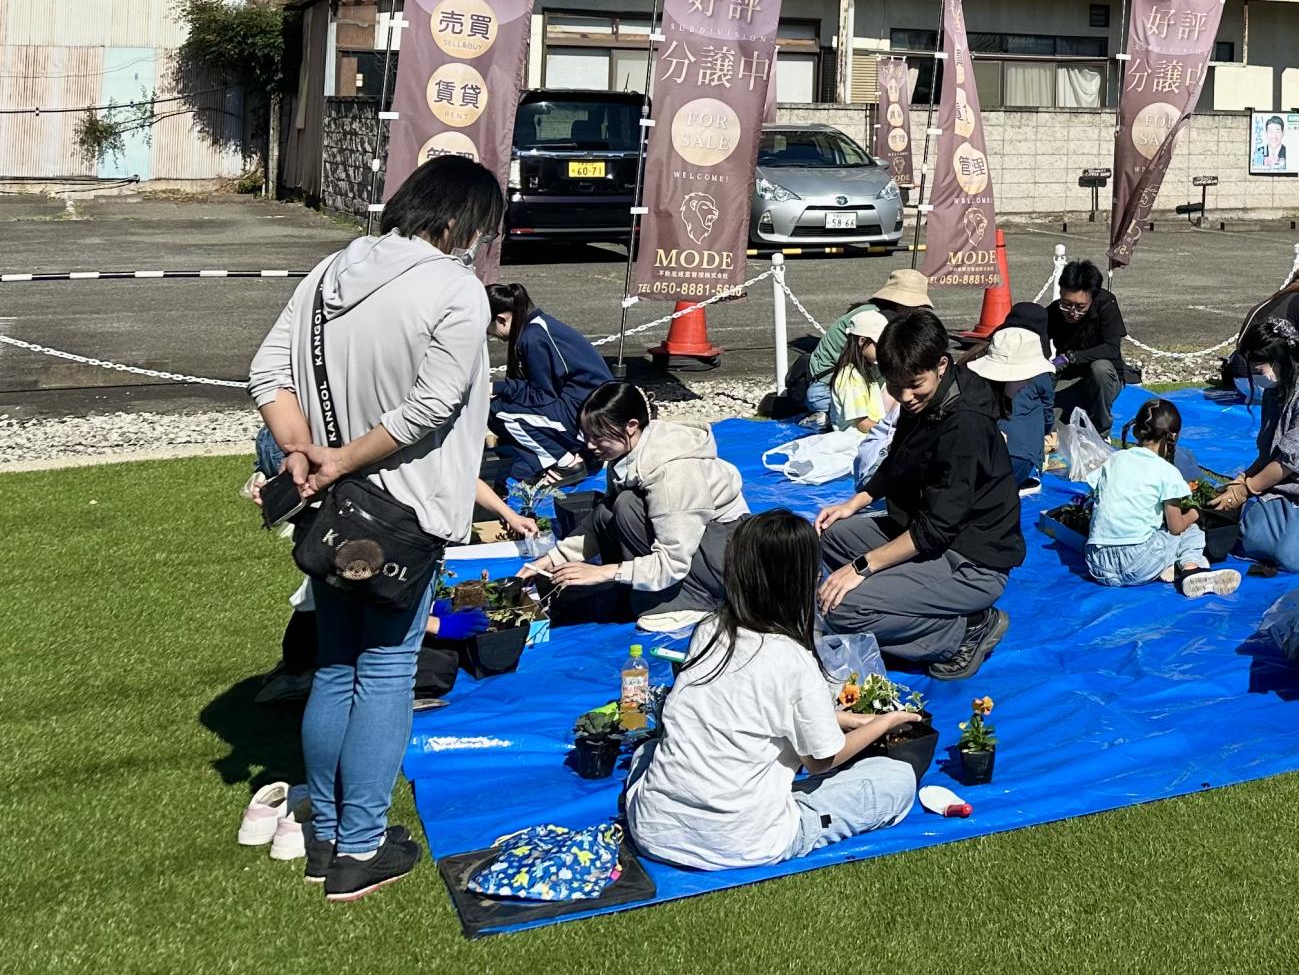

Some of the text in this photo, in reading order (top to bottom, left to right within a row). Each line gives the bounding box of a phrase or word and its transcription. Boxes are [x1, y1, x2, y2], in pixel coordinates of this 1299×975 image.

[438, 10, 493, 41] 売買
[1147, 6, 1208, 42] 好評
[443, 39, 482, 50] SELL&BUY
[660, 40, 770, 91] 分譲中
[433, 79, 482, 109] 賃貸
[444, 110, 469, 120] RENT
[687, 112, 729, 129] FOR
[680, 131, 731, 150] SALE
[577, 166, 601, 176] 60-71
[959, 155, 986, 176] 管理
[673, 170, 729, 183] WELCOME!
[832, 218, 855, 227] 58-66
[654, 248, 734, 270] MODE
[946, 250, 997, 266] MODE
[638, 283, 651, 293] TEL
[319, 380, 337, 442] KANGOL
